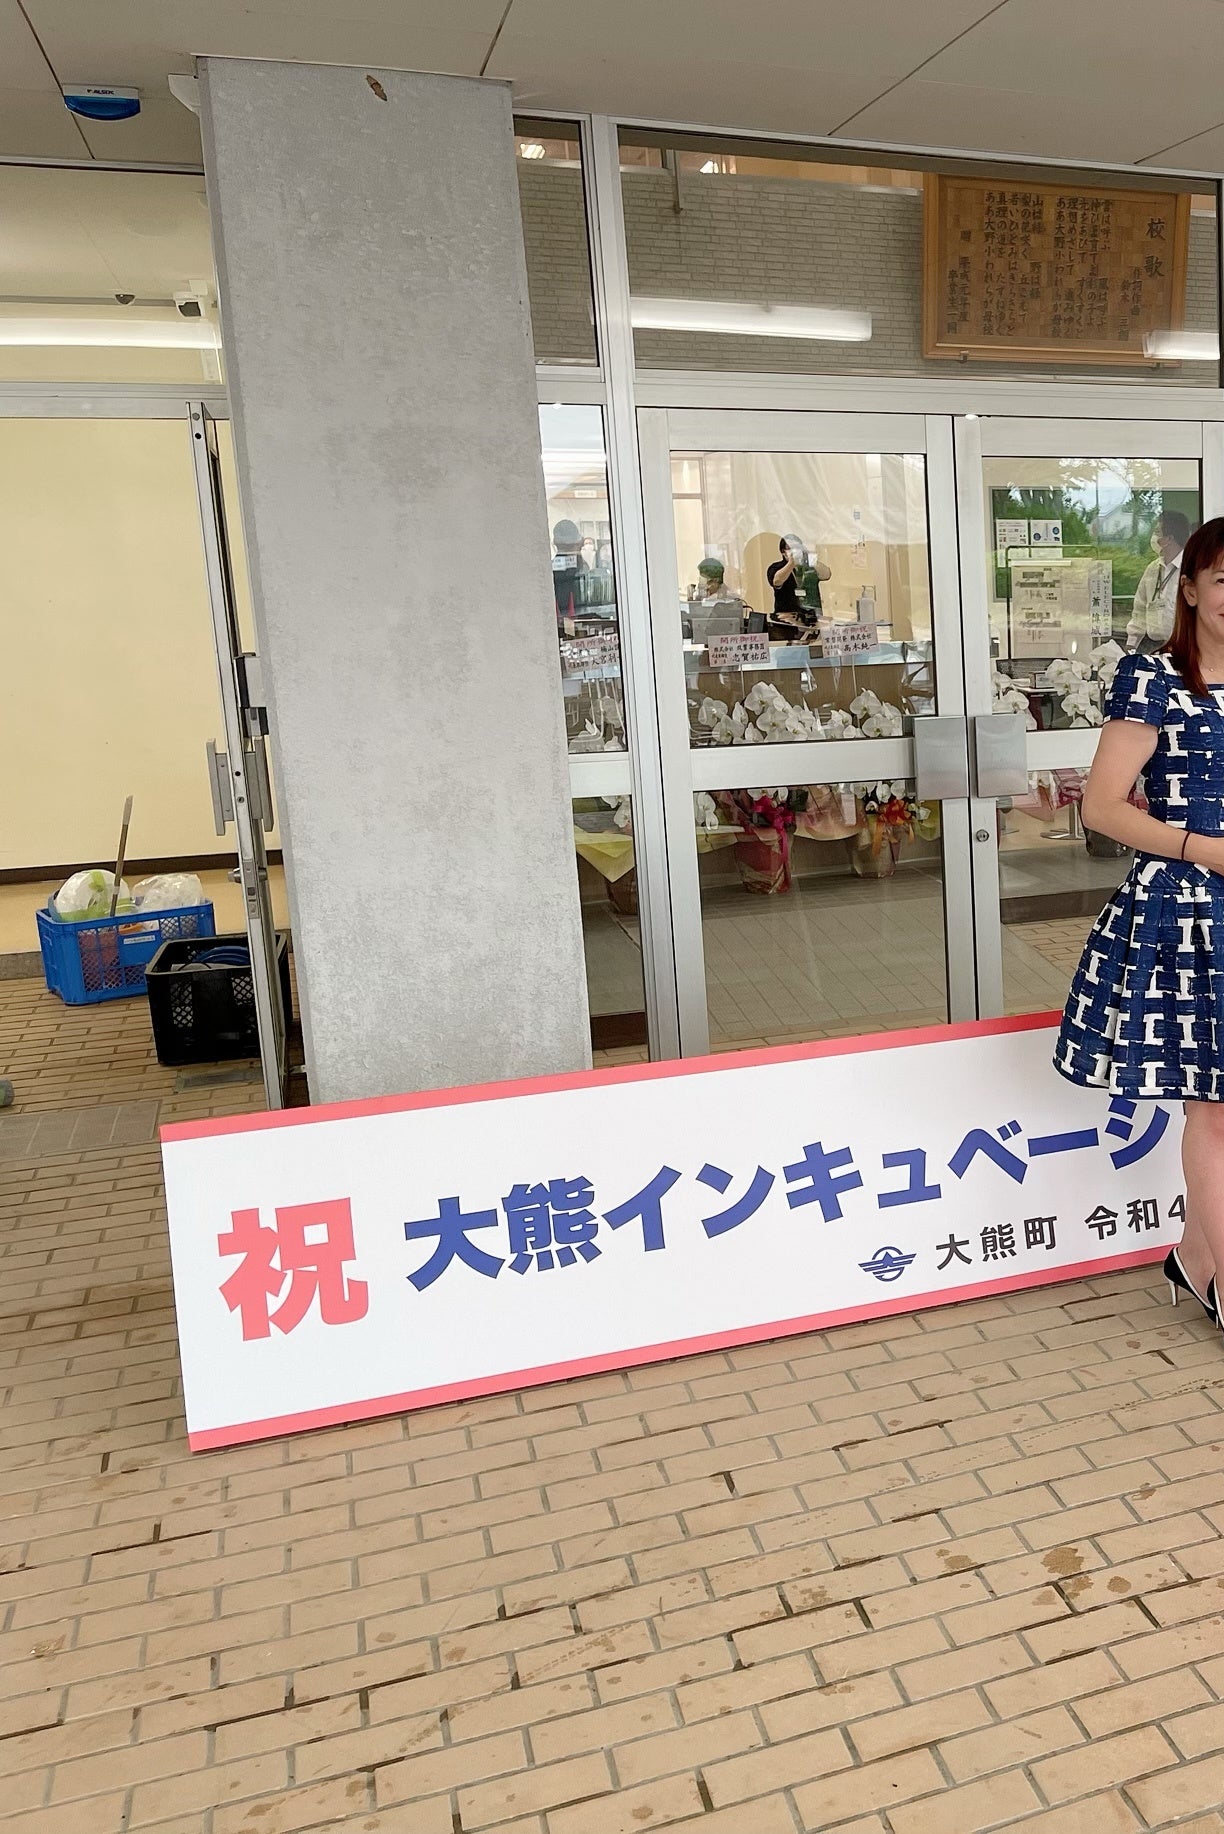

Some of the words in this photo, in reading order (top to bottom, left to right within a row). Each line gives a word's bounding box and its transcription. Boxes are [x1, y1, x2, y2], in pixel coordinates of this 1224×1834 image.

[1144, 217, 1167, 278] 校歌
[217, 1197, 369, 1342] 祝
[935, 1215, 1058, 1271] 大熊町
